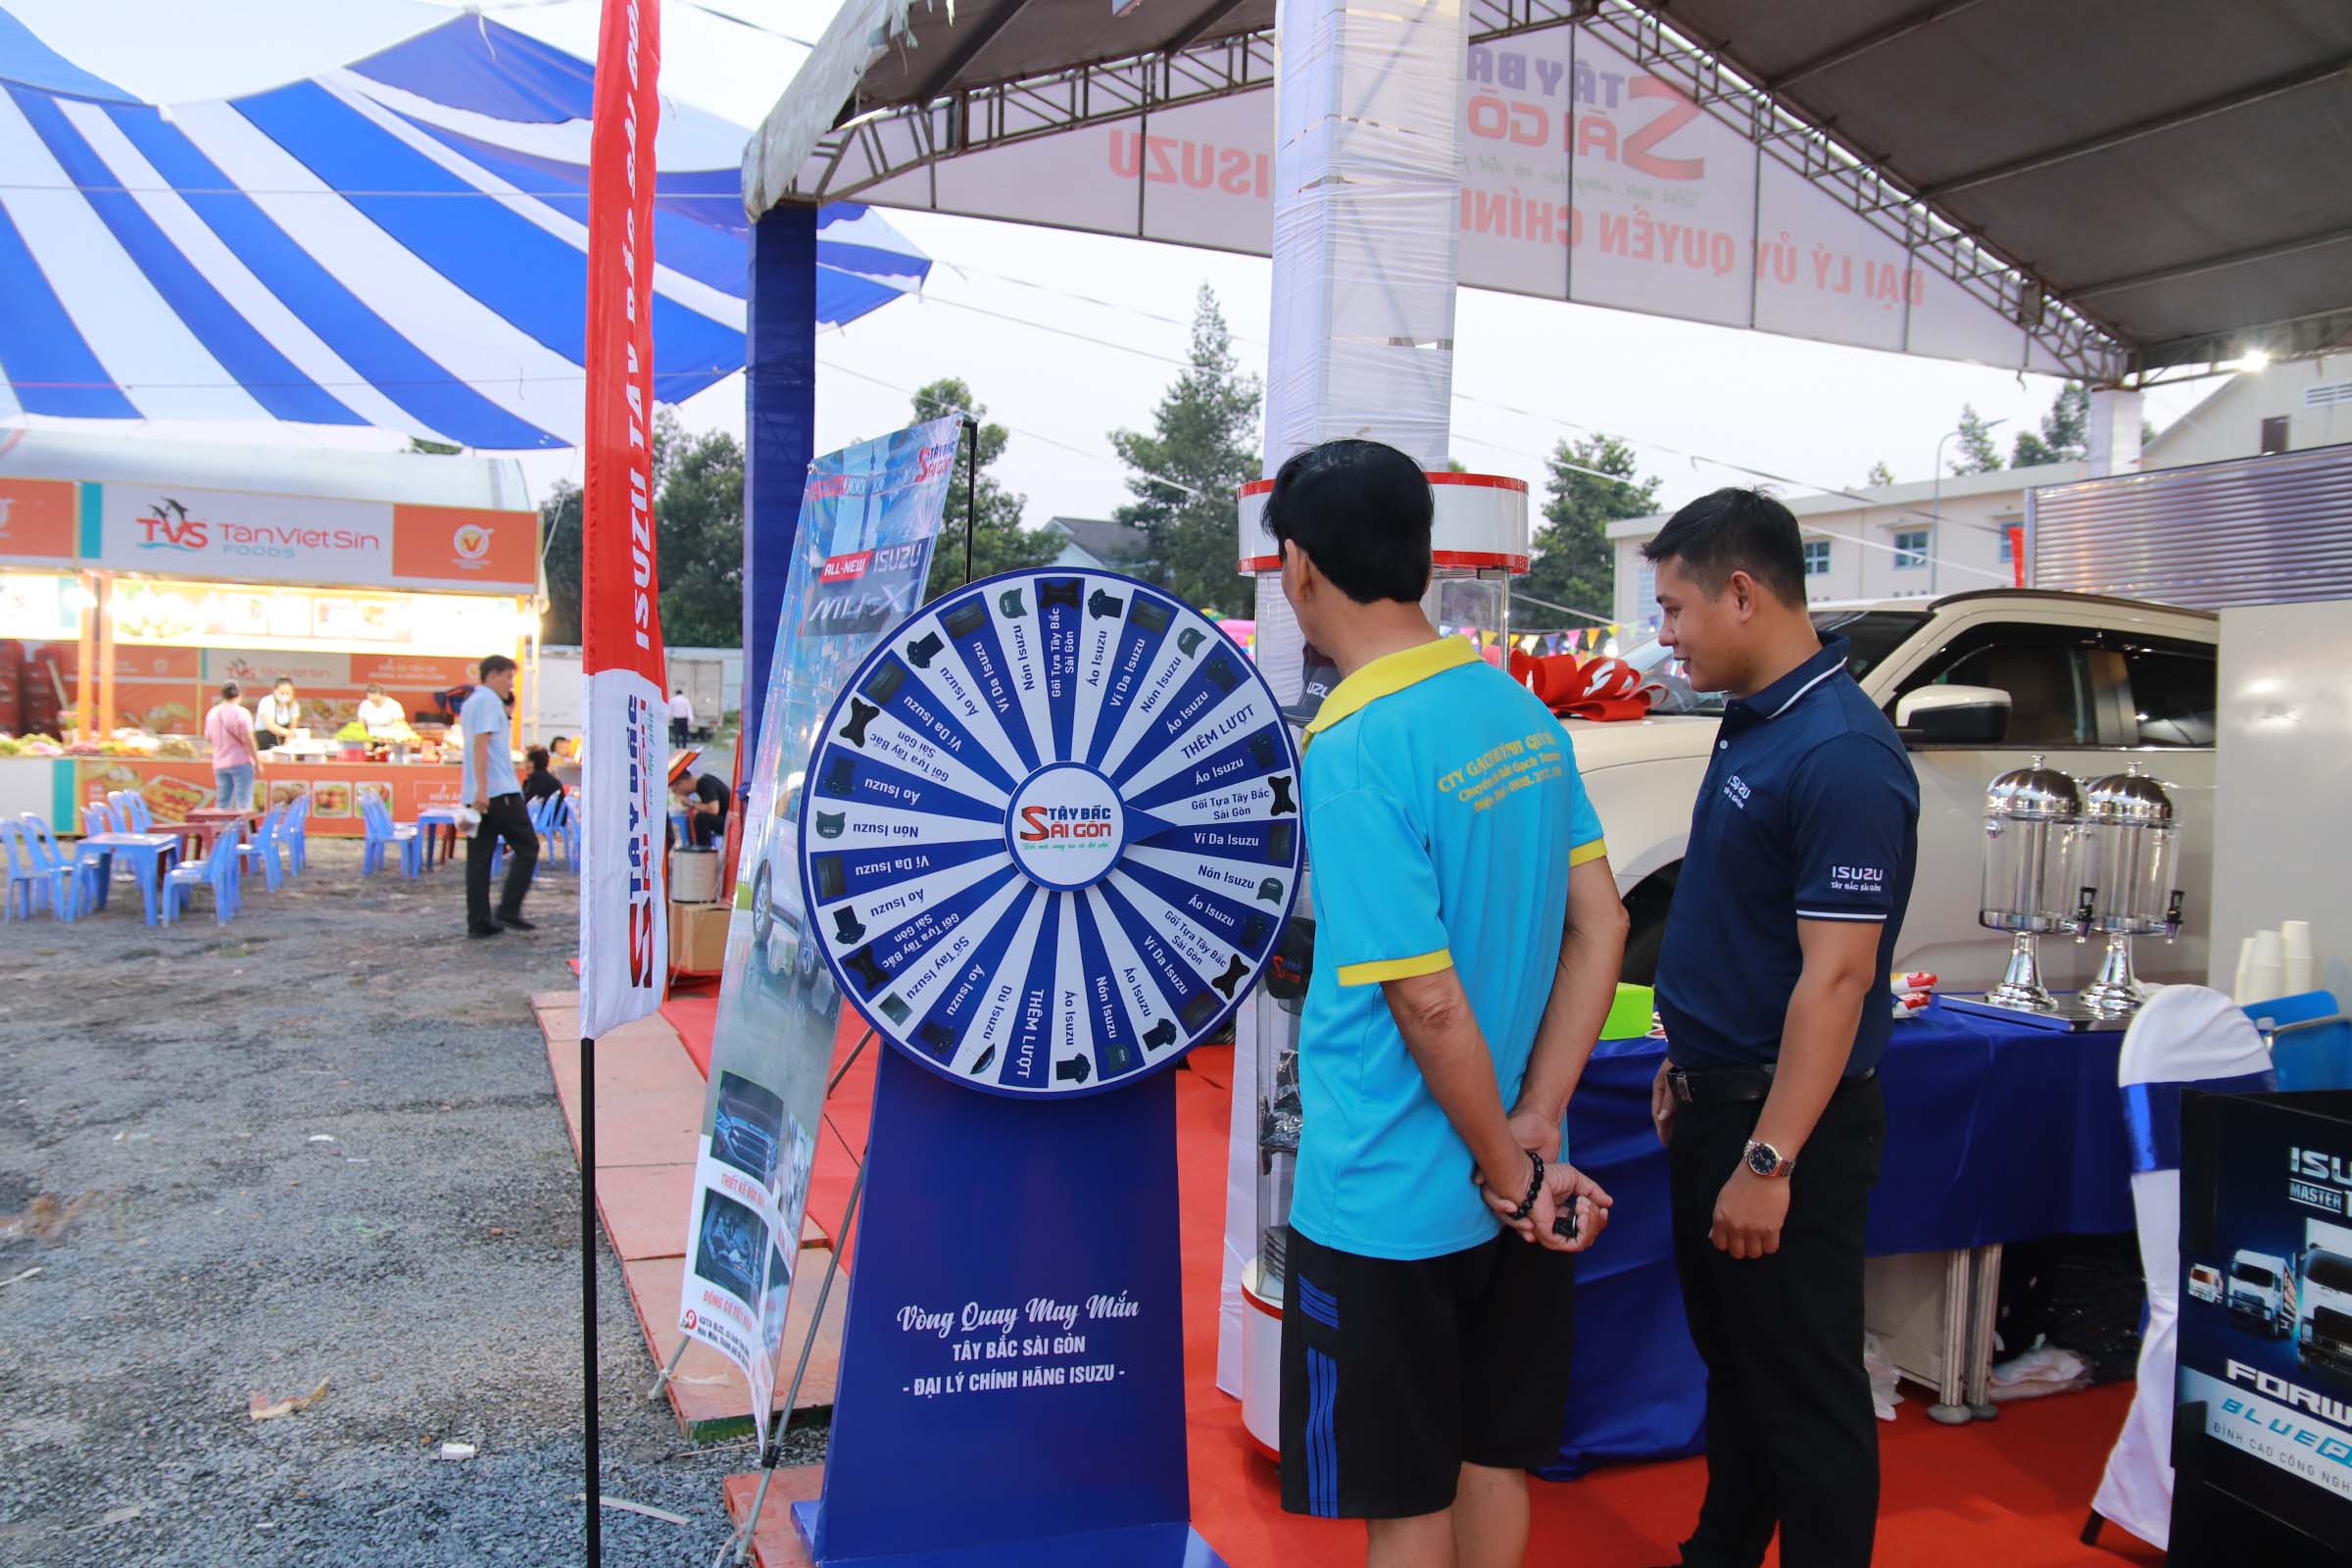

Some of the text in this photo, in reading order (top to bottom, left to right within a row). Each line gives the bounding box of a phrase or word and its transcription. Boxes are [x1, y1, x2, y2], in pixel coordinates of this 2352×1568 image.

[135, 517, 209, 549] TVS
[630, 467, 651, 651] ISUZU
[824, 543, 923, 577] ALL-NEW ISUZU
[1013, 625, 1035, 691] Nón Isuzu
[1049, 608, 1062, 698] Gối Tựa Tây Bắc
[1064, 631, 1075, 674] Sài Gòn
[1086, 630, 1107, 687] Áo Isuzu
[1109, 638, 1146, 708] Ví Da Isuzu
[940, 666, 979, 717] Áo Isuzu
[973, 641, 1010, 713] Ví Da Isuzu
[1141, 657, 1182, 713] Nón Isuzu
[904, 695, 963, 753] Ví Da Isuzu
[1166, 691, 1209, 735] Áo Isuzu
[1180, 704, 1255, 760] THÊM LƯỢT
[869, 733, 950, 782] Gối Tựa Tây Bắc
[898, 731, 936, 759] Sài Gòn
[864, 778, 921, 806] Áo Isuzu
[1195, 758, 1245, 785] Áo Isuzu
[1192, 787, 1270, 810] Gối Tựa Tây Bắc
[1213, 804, 1250, 821] Sài Gòn
[853, 822, 889, 837] Isuzu
[894, 825, 919, 838] Nón
[1194, 832, 1259, 847] Ví Da Isuzu
[855, 855, 930, 876] Ví Da Isuzu
[1198, 863, 1254, 890] Nón Isuzu
[1832, 865, 1883, 881] ISUZU
[870, 888, 924, 917] Áo Isuzu
[1187, 894, 1236, 928] Áo Isuzu
[882, 912, 959, 968] Gối Tựa Tây Bắc
[894, 913, 933, 943] Sài Gòn
[1164, 910, 1227, 968] Gối Tựa Tây Bắc
[1171, 935, 1203, 965] Sài Gòn
[906, 936, 970, 1000] Sổ Tay Isuzu
[1143, 935, 1189, 996] Ví Da Isuzu
[946, 964, 986, 1016] Áo Isuzu
[983, 984, 1012, 1040] Dù Isuzu
[1096, 975, 1118, 1040] Nón Isuzu
[1123, 966, 1152, 1017] Áo Isuzu
[1016, 989, 1045, 1078] THÊM LƯỢT
[1063, 990, 1078, 1046] Áo Isuzu
[2289, 1147, 2352, 1187] ISU
[2289, 1182, 2342, 1210] MASTER
[897, 1290, 1141, 1339] Vòng Quay May Mắn
[953, 1333, 1086, 1362] TÂY BẮC SÀI GÒN
[913, 1377, 942, 1398] ĐẠI
[946, 1372, 965, 1393] LÝ
[969, 1369, 1018, 1391] CHÍNH
[1022, 1366, 1065, 1388] HÃNG
[1069, 1364, 1115, 1384] ISUZU
[2227, 1358, 2352, 1427] FORW
[2222, 1397, 2352, 1468] BLUEP
[2322, 1471, 2350, 1494] NGH
